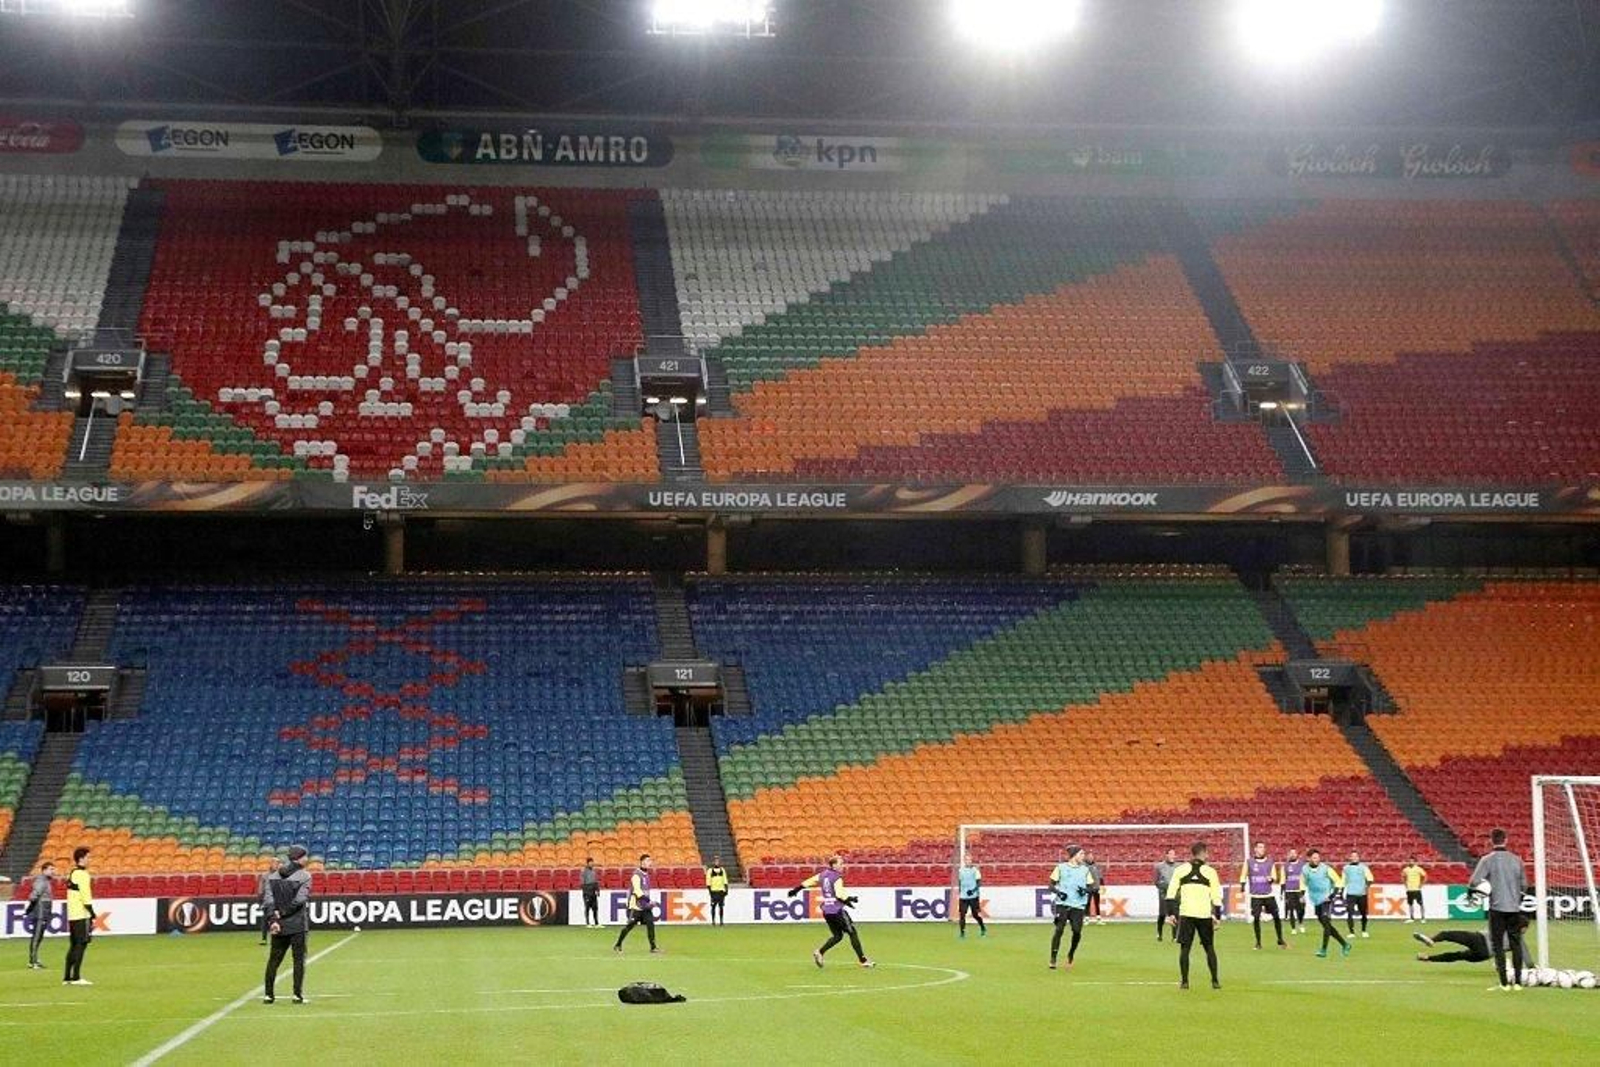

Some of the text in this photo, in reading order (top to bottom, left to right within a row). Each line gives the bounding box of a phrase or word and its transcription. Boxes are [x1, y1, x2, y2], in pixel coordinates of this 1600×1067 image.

[816, 139, 877, 168] kpn
[97, 354, 121, 365] 420
[659, 360, 679, 371] 421
[1248, 365, 1269, 375] 422
[42, 486, 118, 502] LEAGUE
[352, 486, 429, 509] FedEx
[649, 492, 846, 507] UEFA EUROPA LEAGUE
[1346, 492, 1539, 507] UEFA EUROPA LEAGUE
[66, 671, 91, 682] 120
[675, 668, 693, 680] 121
[1310, 668, 1331, 679] 122
[208, 898, 519, 928] UEF UROPA LEAGUE
[610, 891, 707, 922] FdEx
